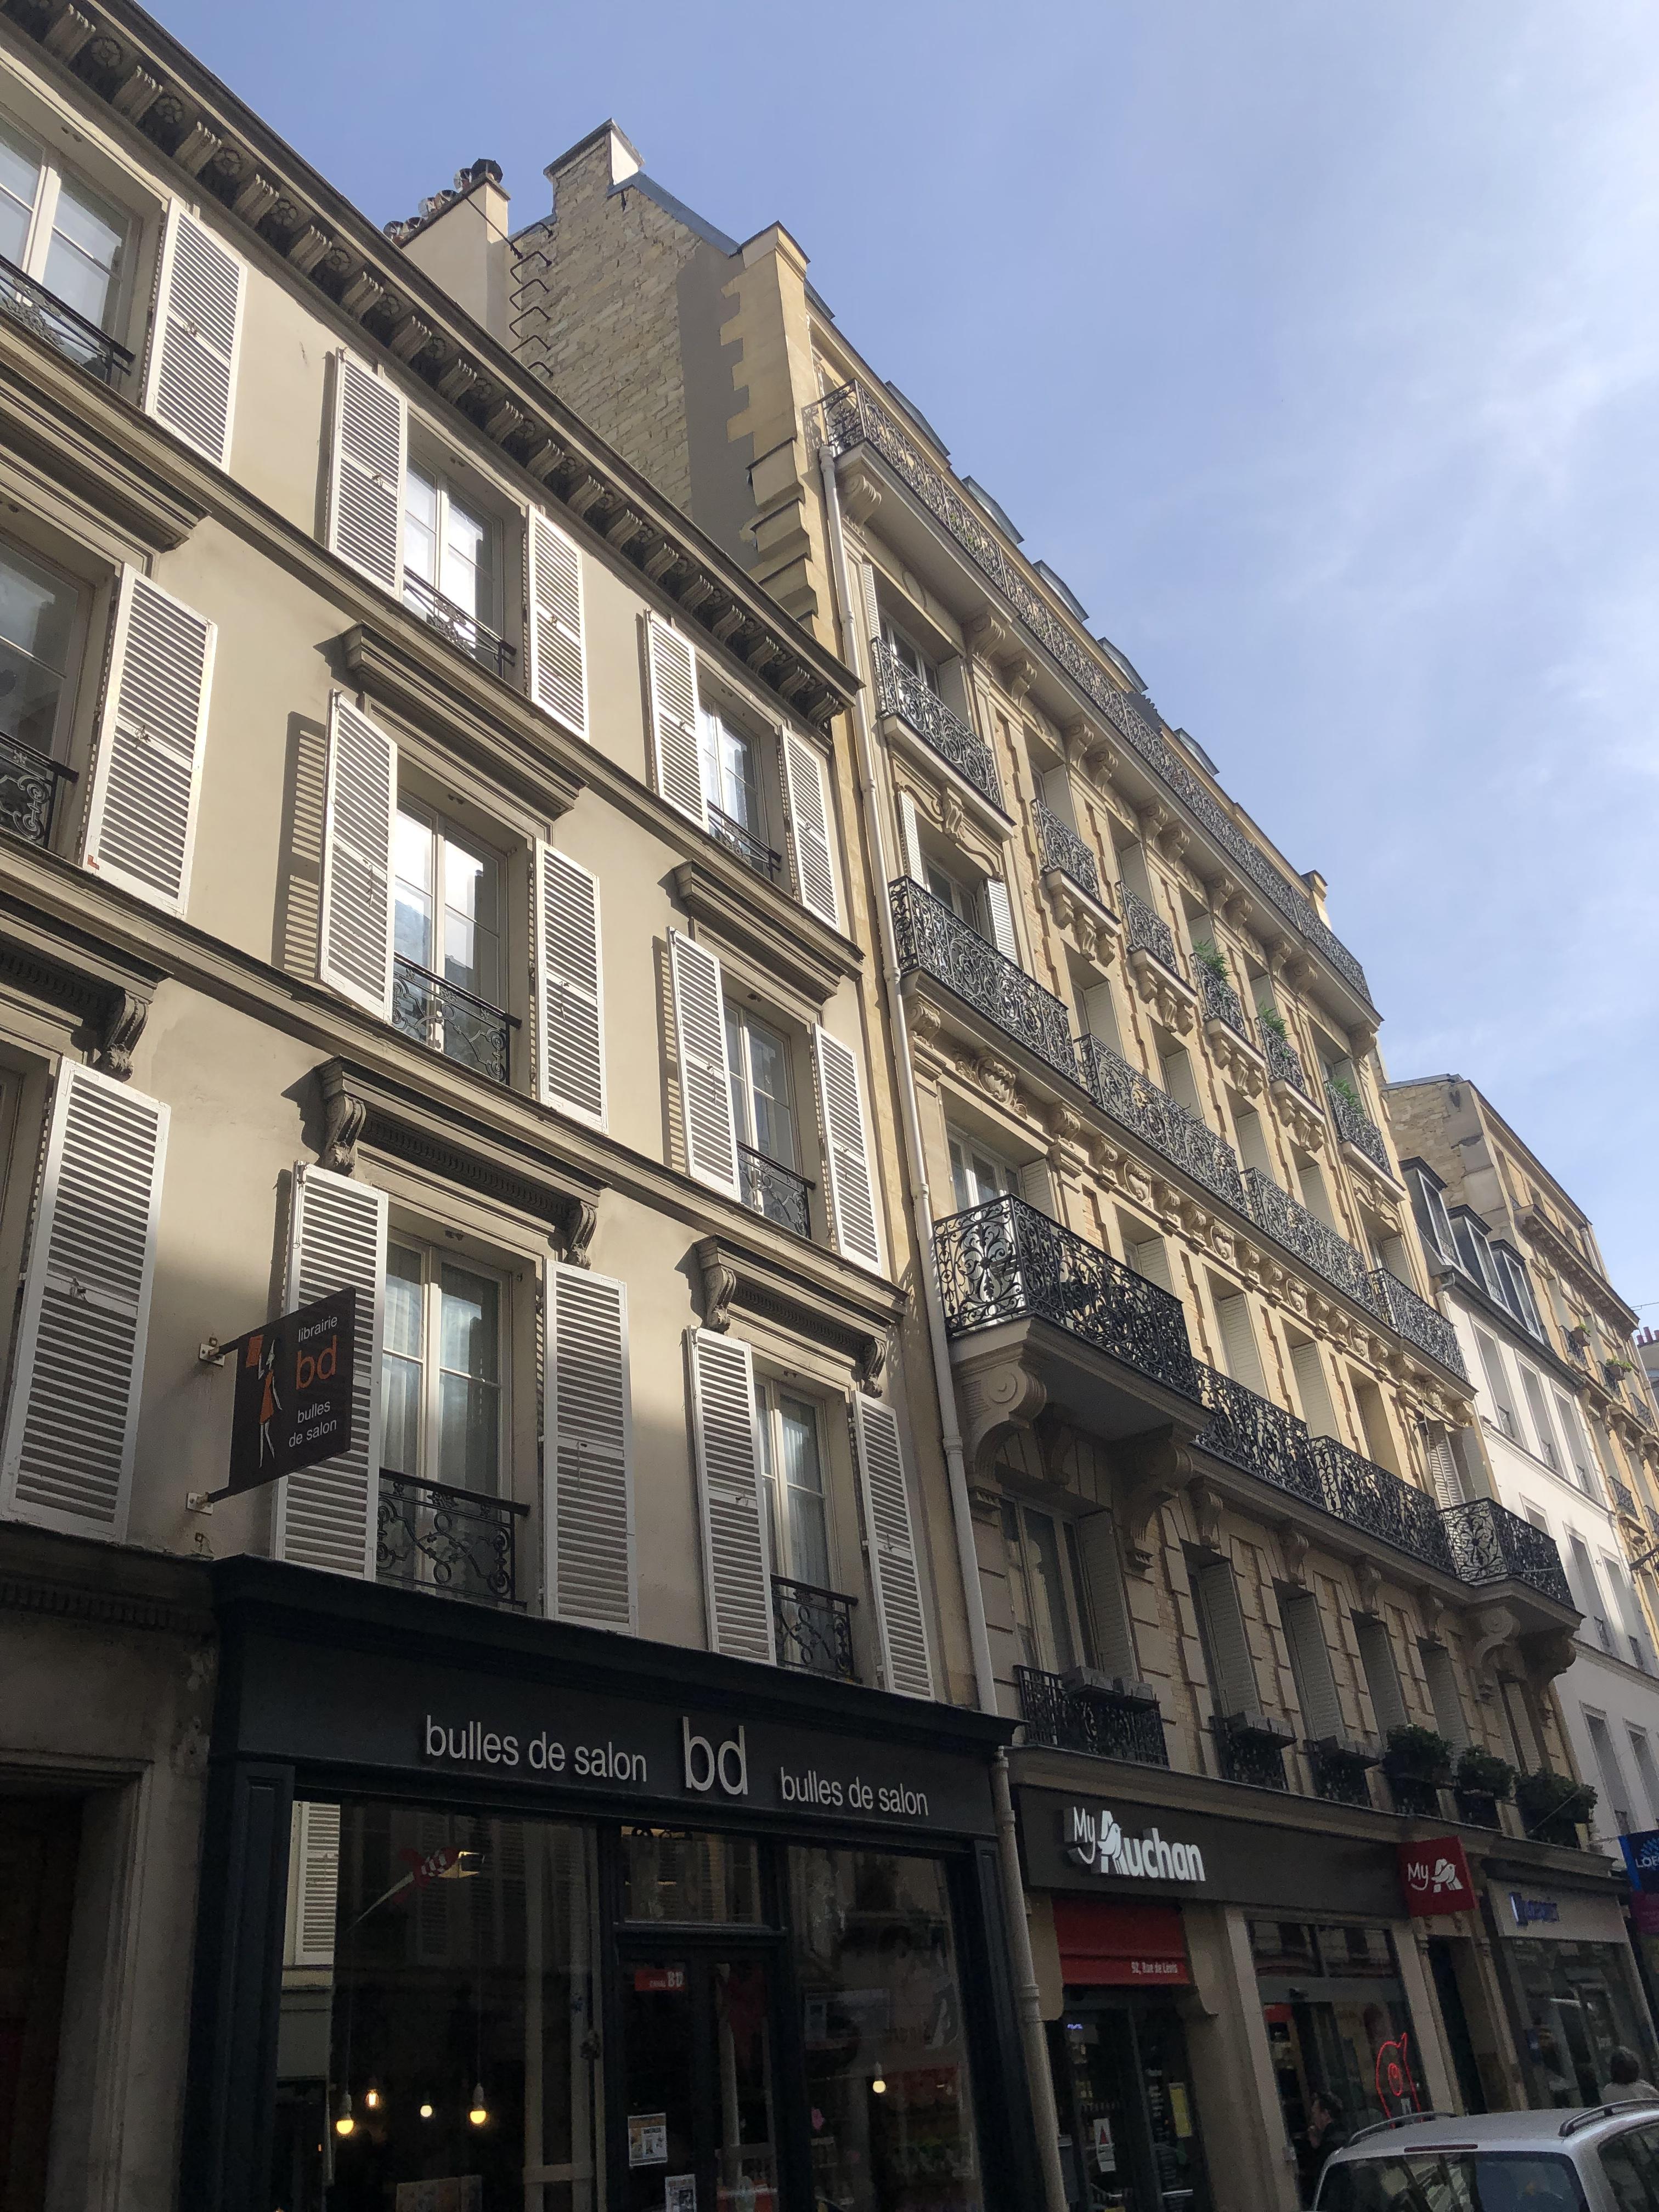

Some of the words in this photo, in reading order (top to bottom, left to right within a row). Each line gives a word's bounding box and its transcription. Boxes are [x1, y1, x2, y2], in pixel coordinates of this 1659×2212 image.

[298, 1315, 338, 1343] librairie
[295, 1334, 338, 1391] bd
[289, 1430, 303, 1448] de
[306, 1418, 337, 1441] salon
[297, 1400, 331, 1424] bulles
[426, 1714, 519, 1765] bulles
[528, 1731, 565, 1771] de
[574, 1741, 647, 1782] salon
[682, 1716, 748, 1795] bd
[781, 1767, 843, 1807] bulles
[848, 1776, 873, 1809] de
[878, 1783, 929, 1816] salon
[1074, 1807, 1096, 1864] My
[1098, 1810, 1206, 1881] Auchan
[1407, 1861, 1429, 1891] My
